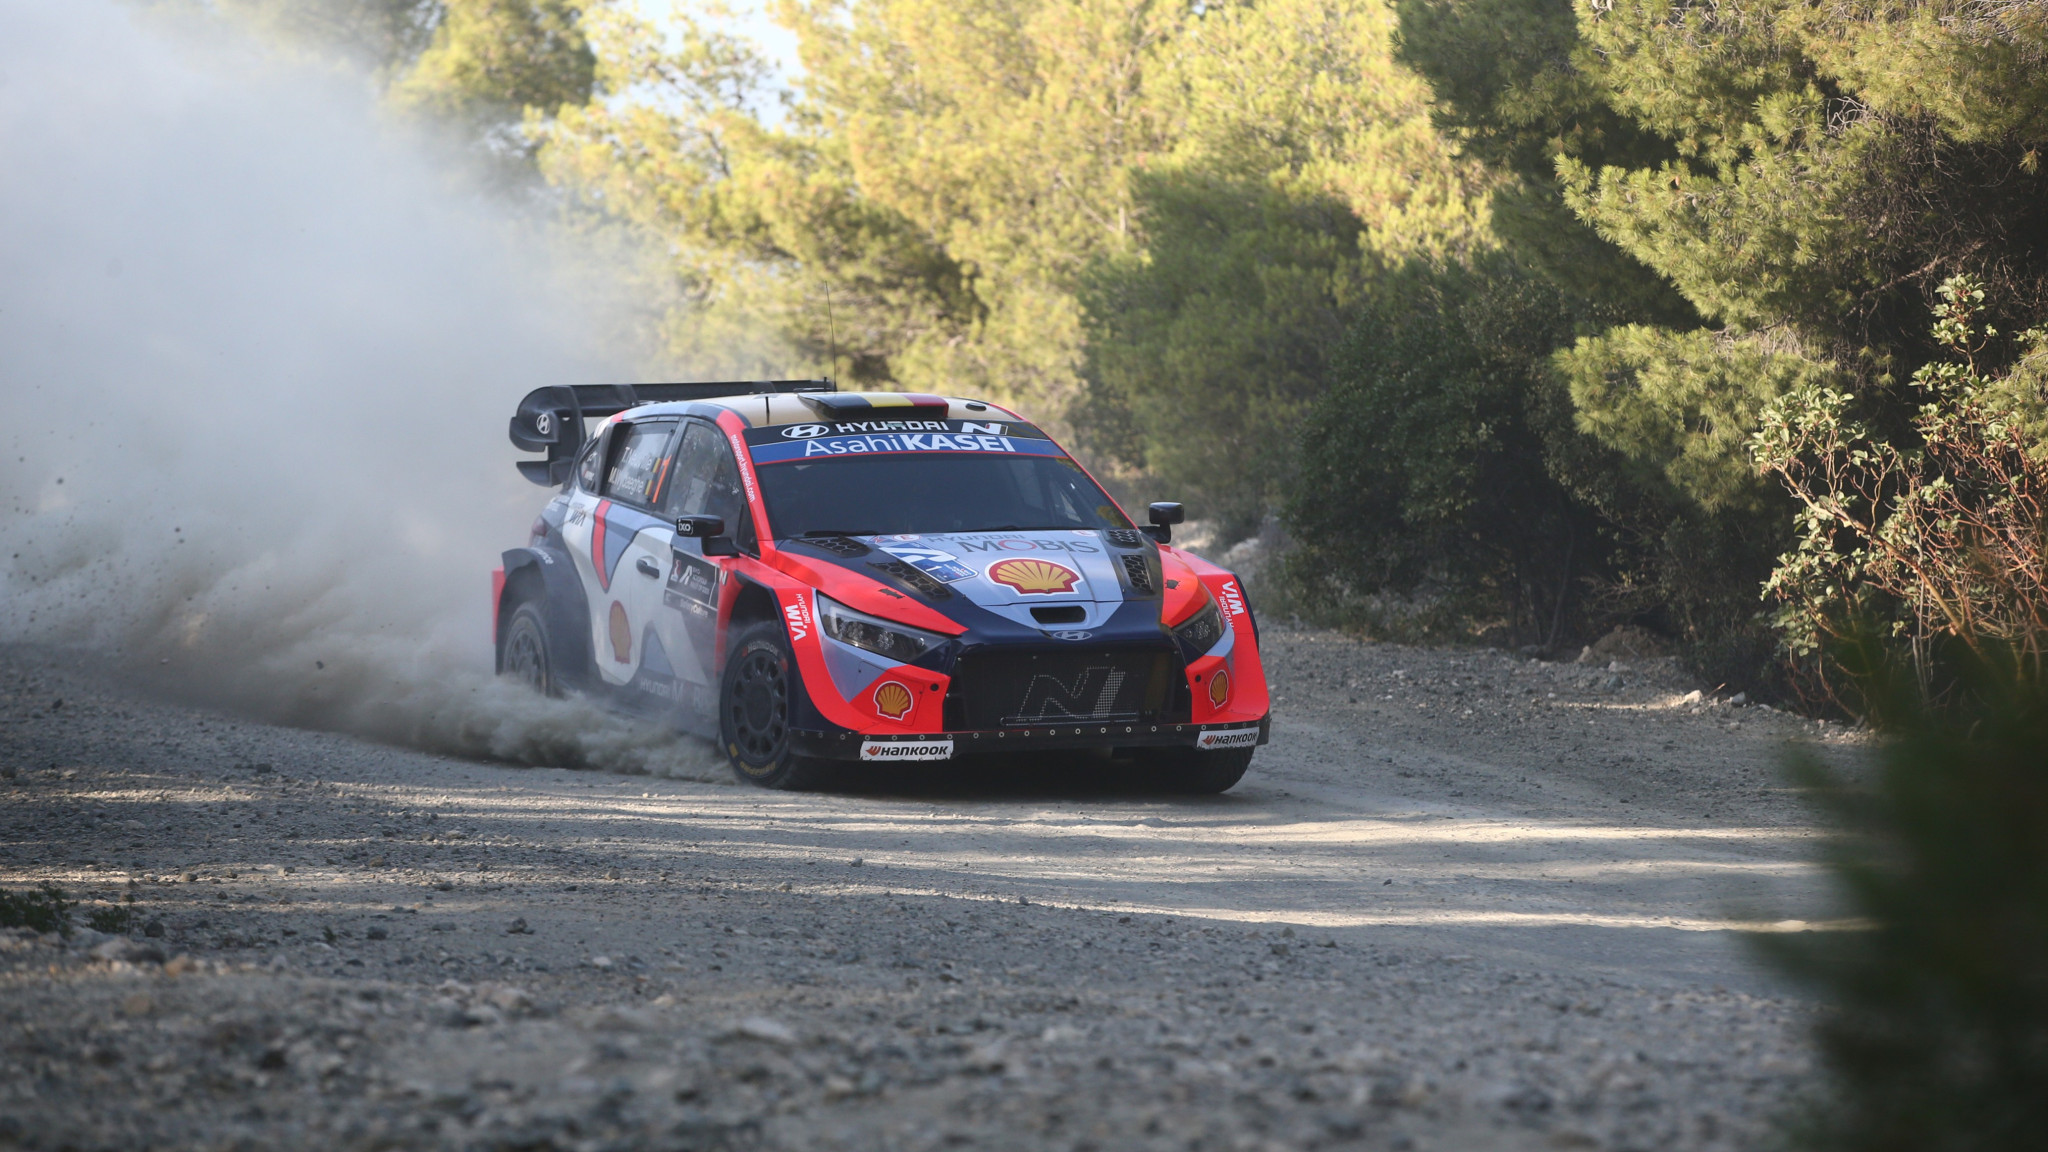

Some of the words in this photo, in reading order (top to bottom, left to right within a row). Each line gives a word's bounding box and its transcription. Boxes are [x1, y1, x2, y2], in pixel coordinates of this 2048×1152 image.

[835, 420, 949, 433] HYUNDAI
[730, 433, 756, 503] motorsport.hyundai.com
[926, 534, 1026, 543] HYUNDAI
[955, 539, 1099, 553] MOBIS
[795, 593, 811, 624] HYUNDAI
[1222, 580, 1245, 616] WIA
[784, 604, 808, 641] WIA
